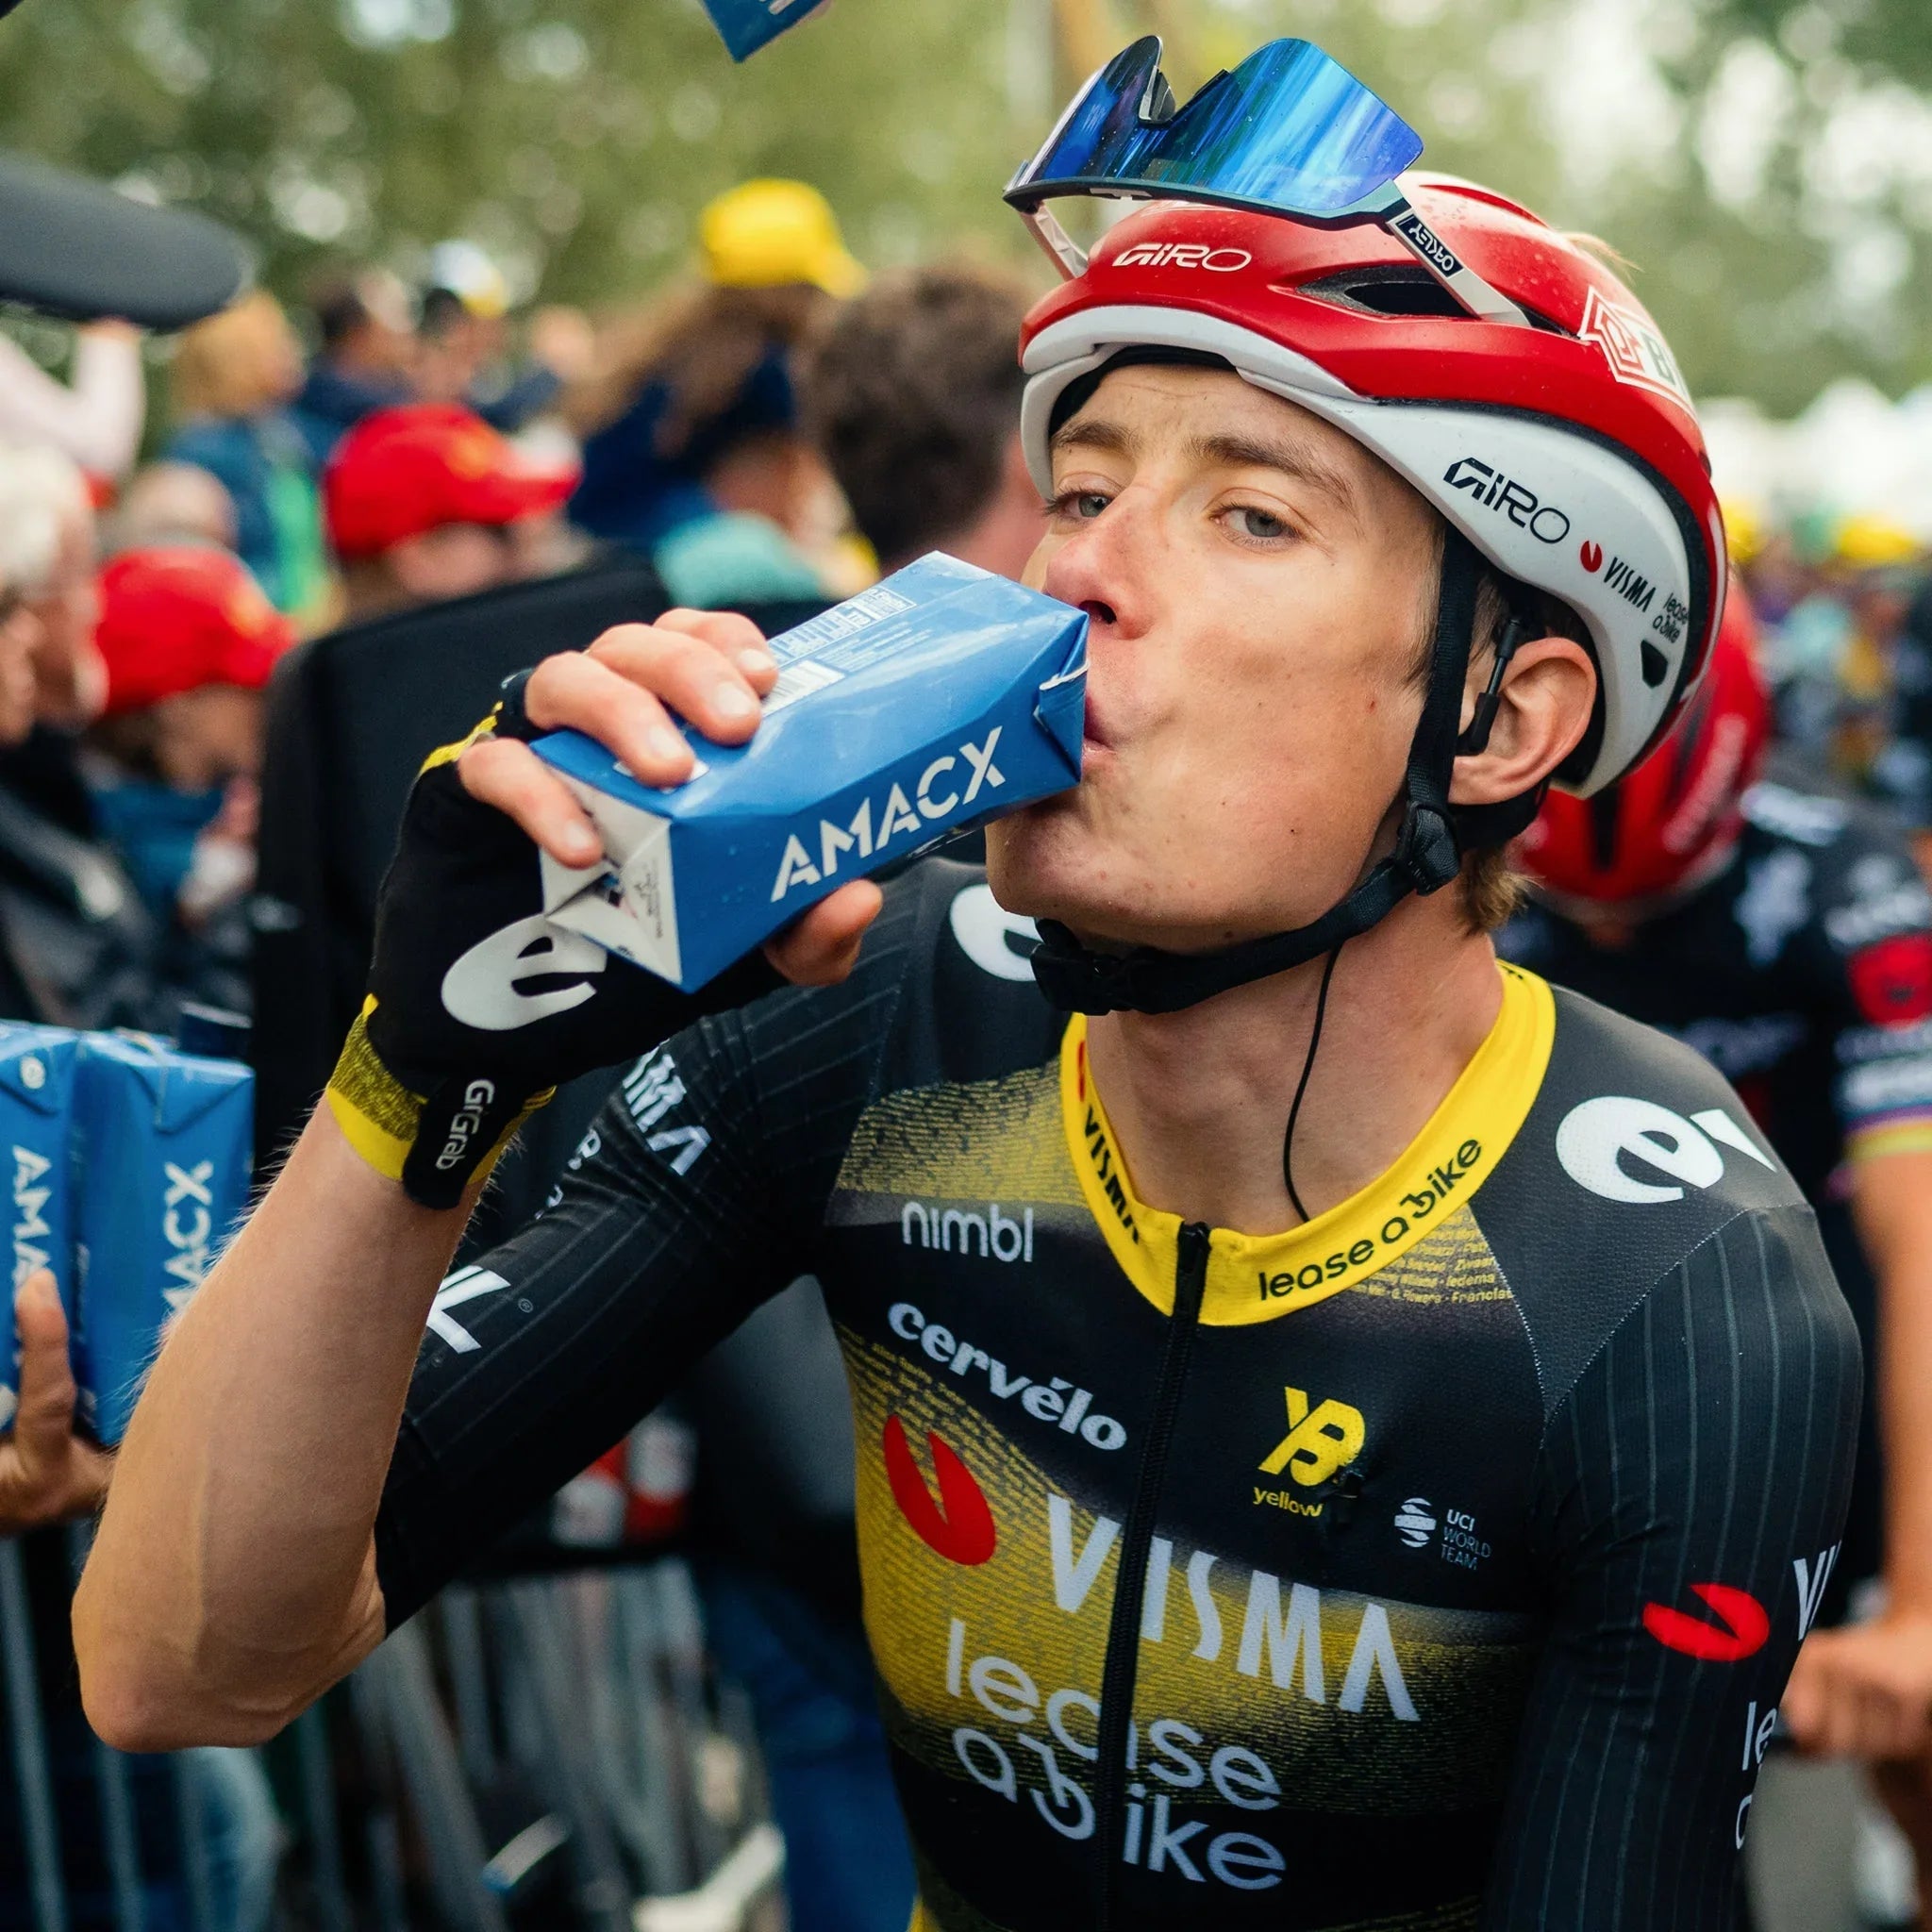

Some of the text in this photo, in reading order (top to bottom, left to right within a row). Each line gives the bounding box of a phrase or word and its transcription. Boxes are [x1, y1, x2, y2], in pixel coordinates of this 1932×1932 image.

[1111, 242, 1253, 272] GIRO
[1407, 223, 1454, 271] OAKLEY
[1442, 457, 1571, 544] GIRO
[1603, 556, 1657, 613] VISMA
[770, 724, 1007, 904] AMACX
[622, 1039, 712, 1176] SMA
[1085, 1105, 1140, 1246] VISMA
[12, 1143, 53, 1294] AMA
[901, 1201, 1034, 1263] nimbl
[1257, 1239, 1374, 1301] lease
[888, 1302, 1128, 1451] cervélo
[1253, 1486, 1324, 1518] yellow
[1445, 1508, 1475, 1532] UCI
[1440, 1542, 1478, 1571] TEAM
[1442, 1526, 1492, 1559] WORLD
[1047, 1492, 1422, 1723] VISMA
[945, 1617, 1283, 1810] lease
